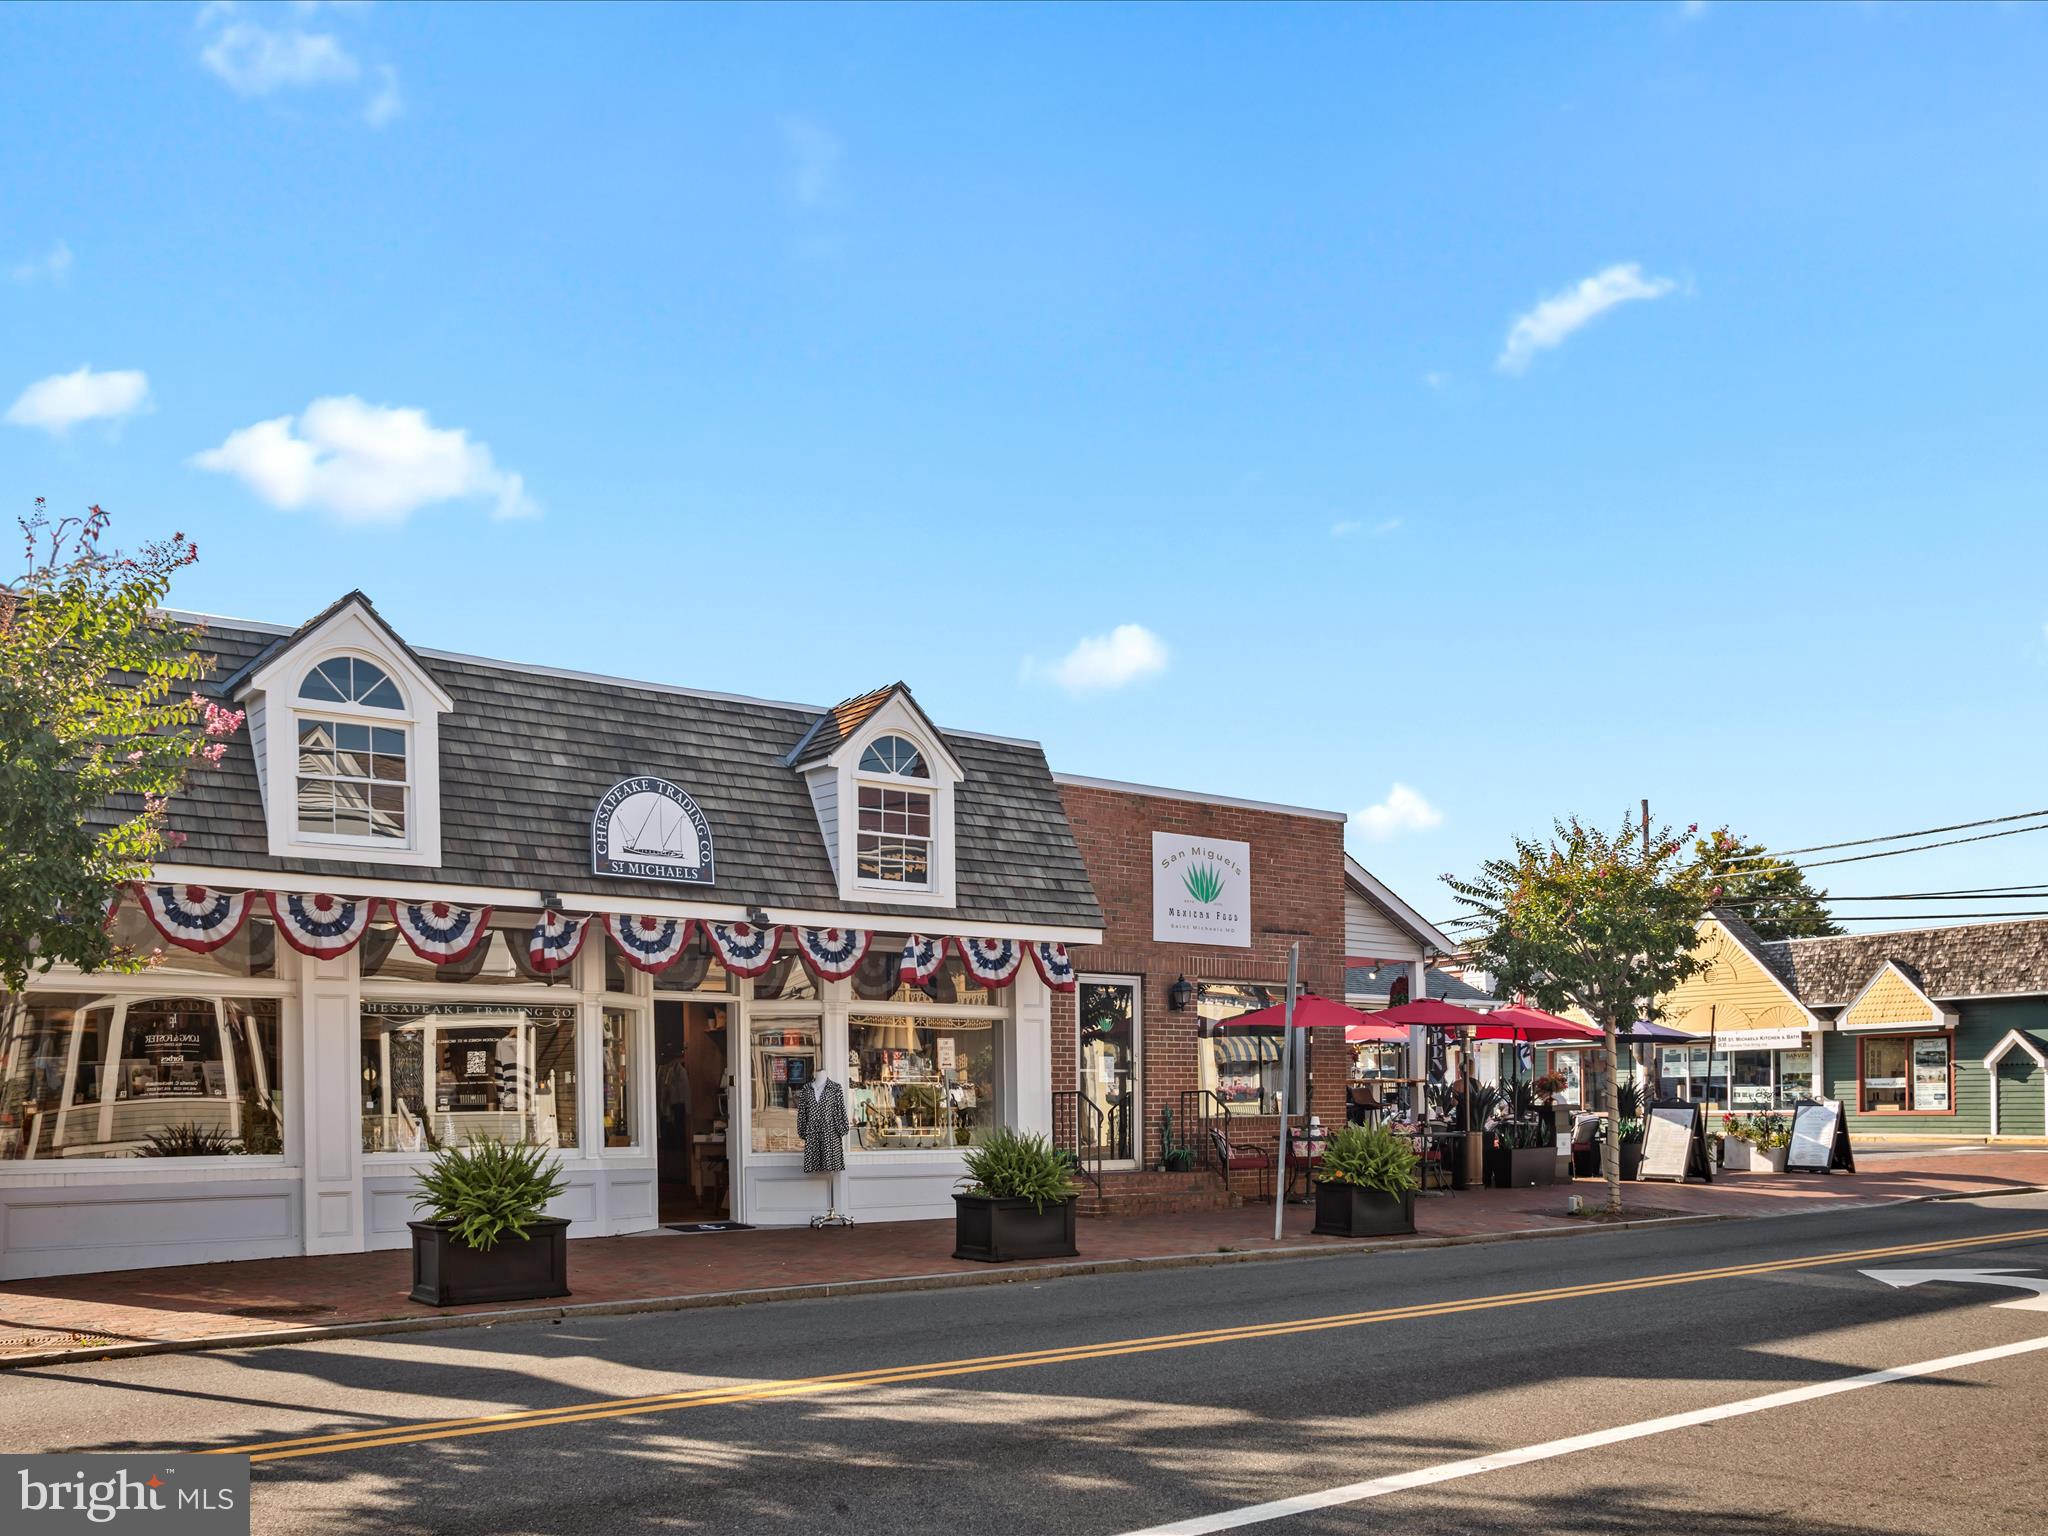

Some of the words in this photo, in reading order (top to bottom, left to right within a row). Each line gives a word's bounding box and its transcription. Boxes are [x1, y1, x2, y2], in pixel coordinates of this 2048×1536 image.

[597, 780, 650, 854] CHESAPEAKE
[657, 781, 707, 836] TRADING
[700, 840, 711, 867] CO.
[628, 862, 698, 879] MICHAELS
[1161, 850, 1185, 869] San
[1191, 847, 1242, 876] Miguels
[474, 1006, 543, 1017] TRADING
